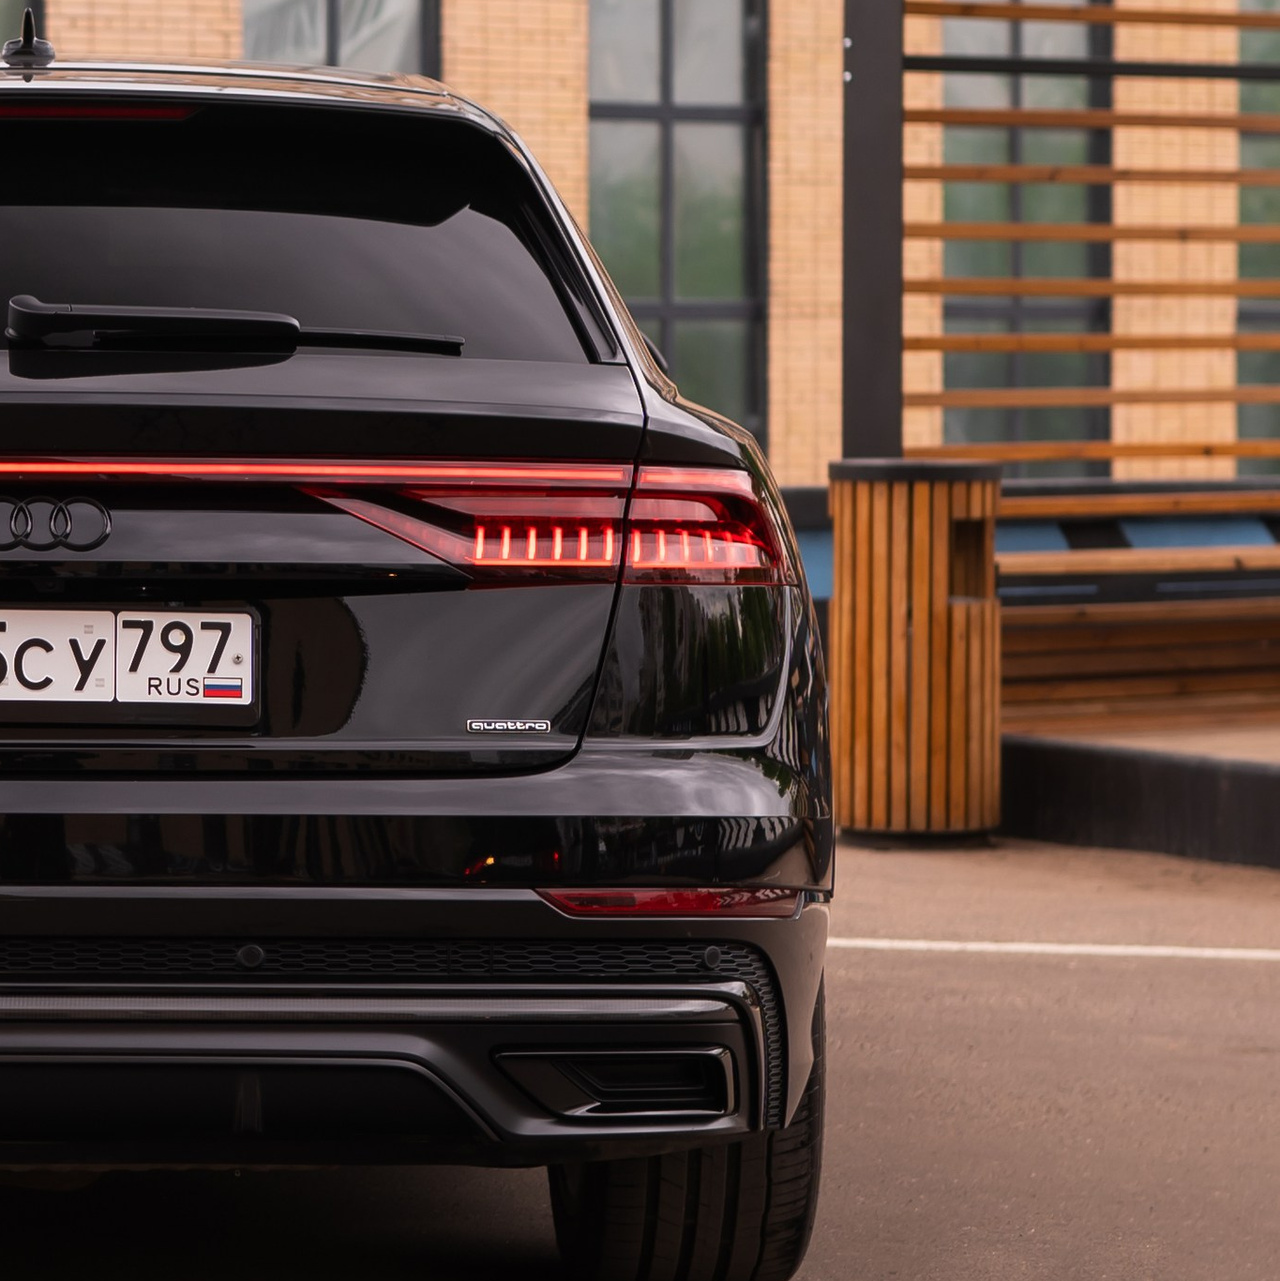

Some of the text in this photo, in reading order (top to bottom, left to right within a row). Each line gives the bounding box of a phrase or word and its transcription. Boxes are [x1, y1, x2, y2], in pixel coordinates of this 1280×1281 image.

[121, 619, 232, 674] 797
[147, 677, 200, 697] RUS
[471, 721, 547, 731] quattro
